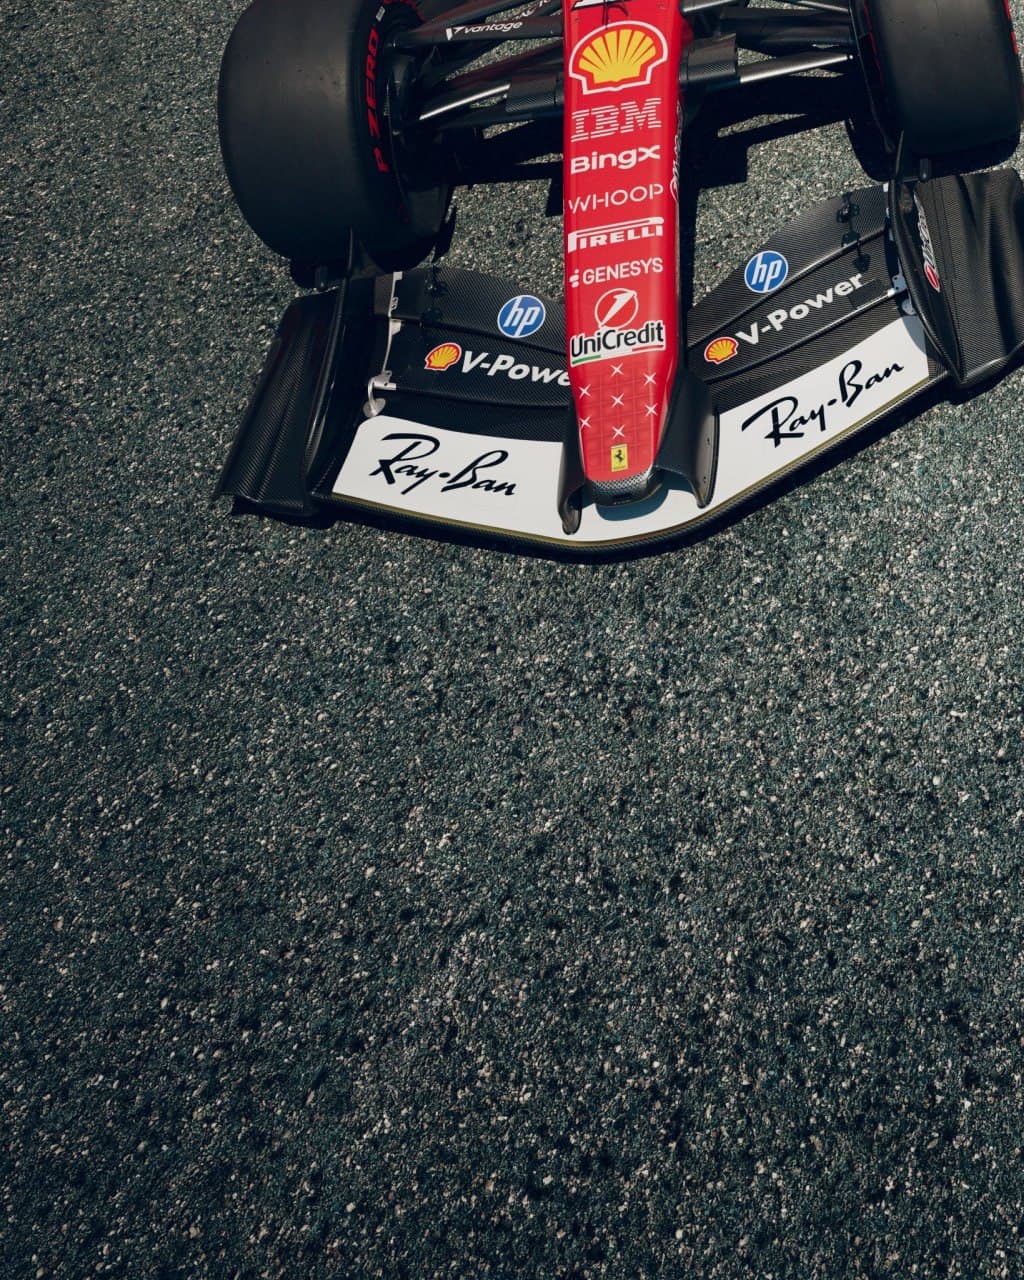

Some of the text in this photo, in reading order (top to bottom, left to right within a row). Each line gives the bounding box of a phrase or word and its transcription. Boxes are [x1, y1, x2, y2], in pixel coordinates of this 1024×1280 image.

[461, 21, 523, 35] vantage
[366, 28, 380, 138] ZERO
[571, 98, 661, 142] IBM
[568, 184, 664, 214] WHOOP
[568, 217, 664, 253] PIRELLI
[582, 257, 663, 284] GENESYS
[749, 251, 784, 292] hp
[502, 295, 542, 337] hp
[735, 272, 864, 345] V-Power
[571, 322, 664, 357] UniCredit
[462, 351, 572, 386] V-Powe
[741, 360, 904, 448] Ray-Ban
[368, 433, 517, 495] Ray-Ban
